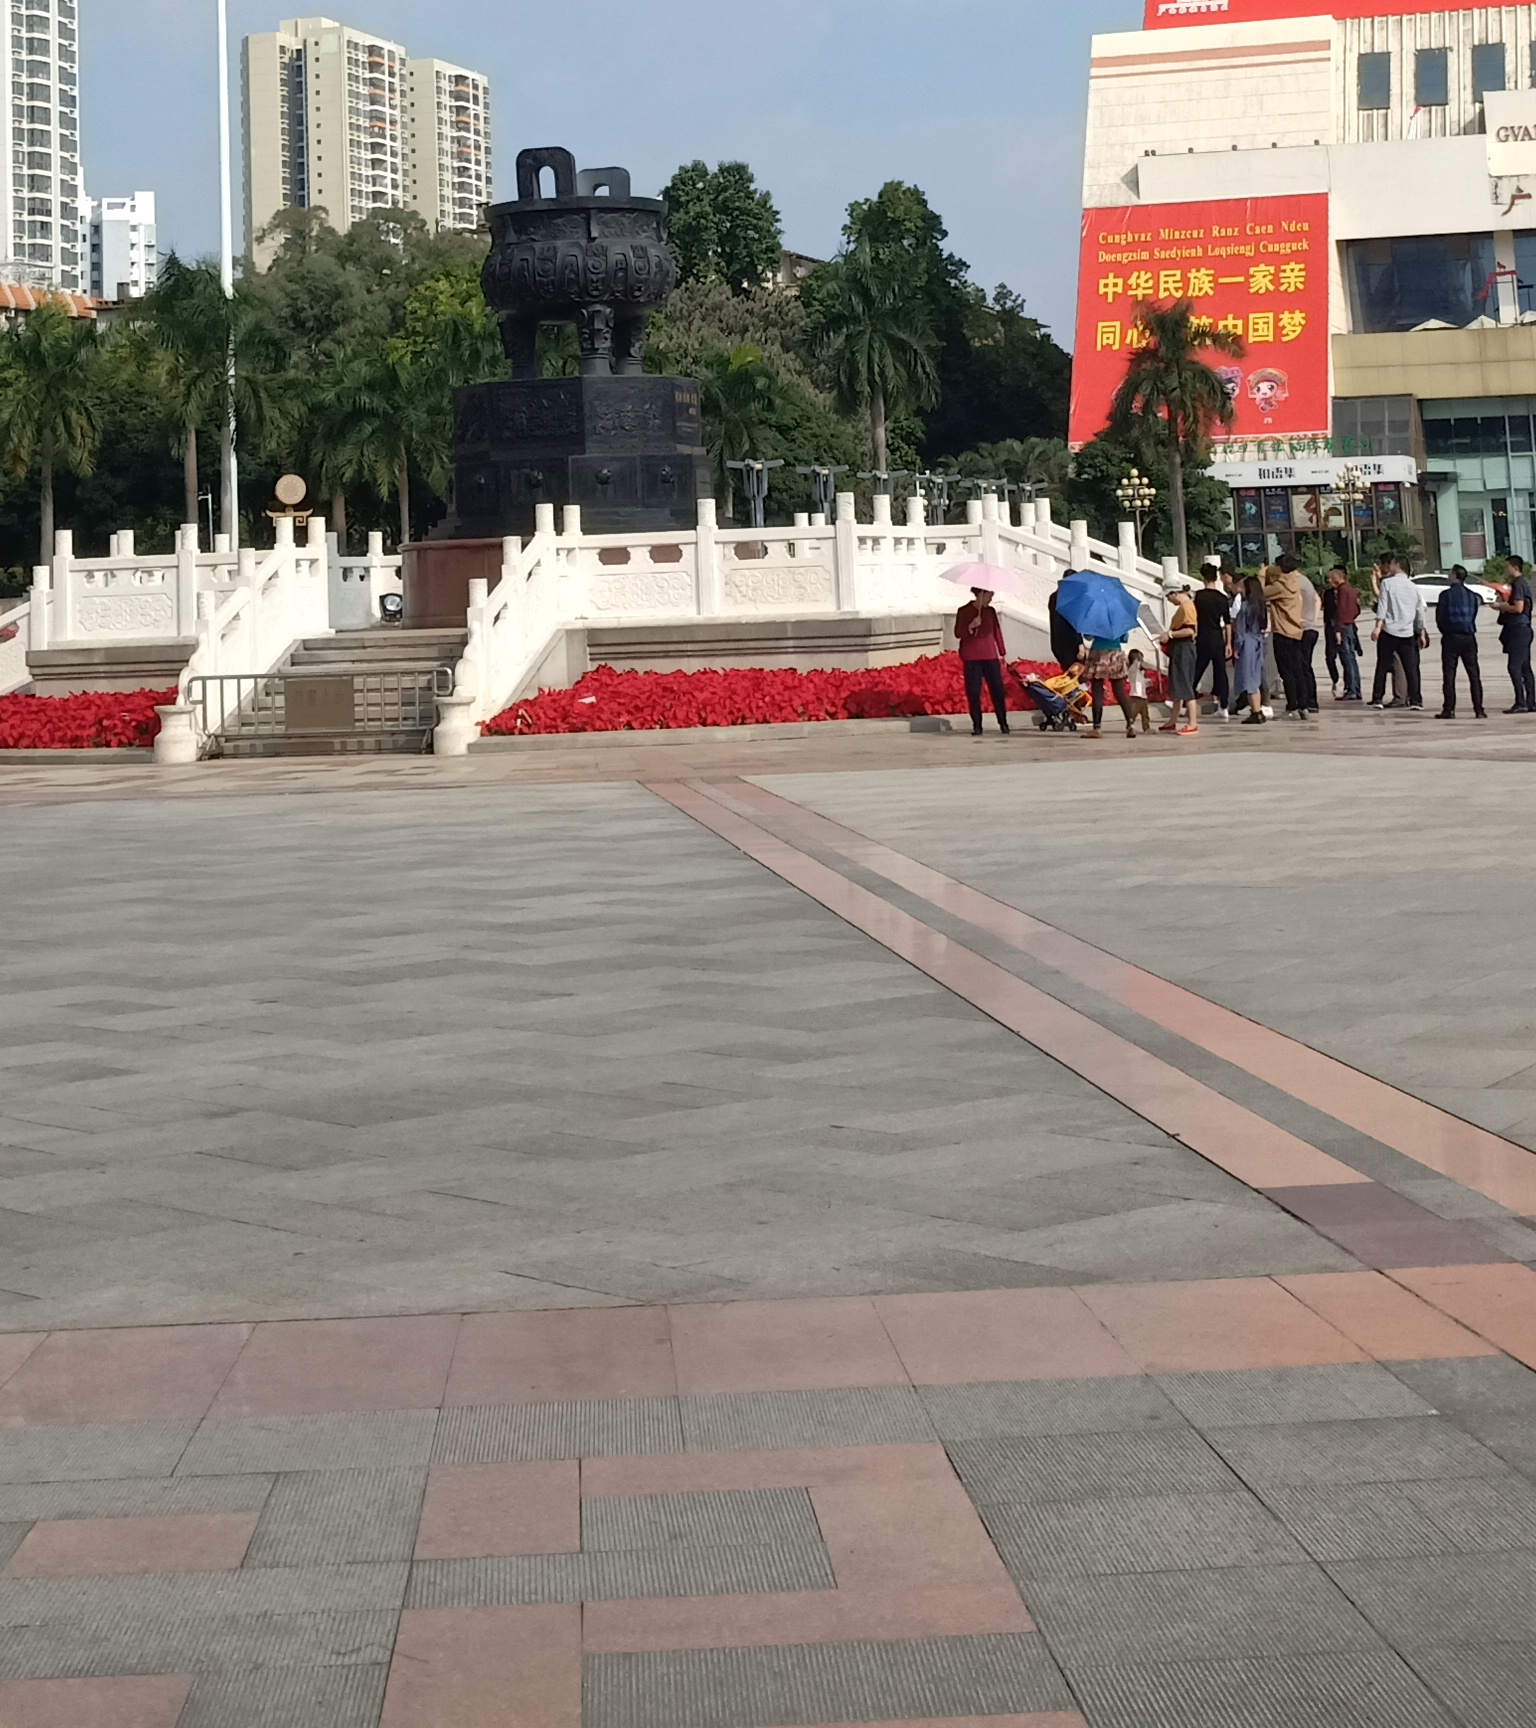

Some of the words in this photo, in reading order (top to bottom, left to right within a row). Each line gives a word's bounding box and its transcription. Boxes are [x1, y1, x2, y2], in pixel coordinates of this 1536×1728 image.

[1098, 261, 1307, 304] 中华民族一家亲
